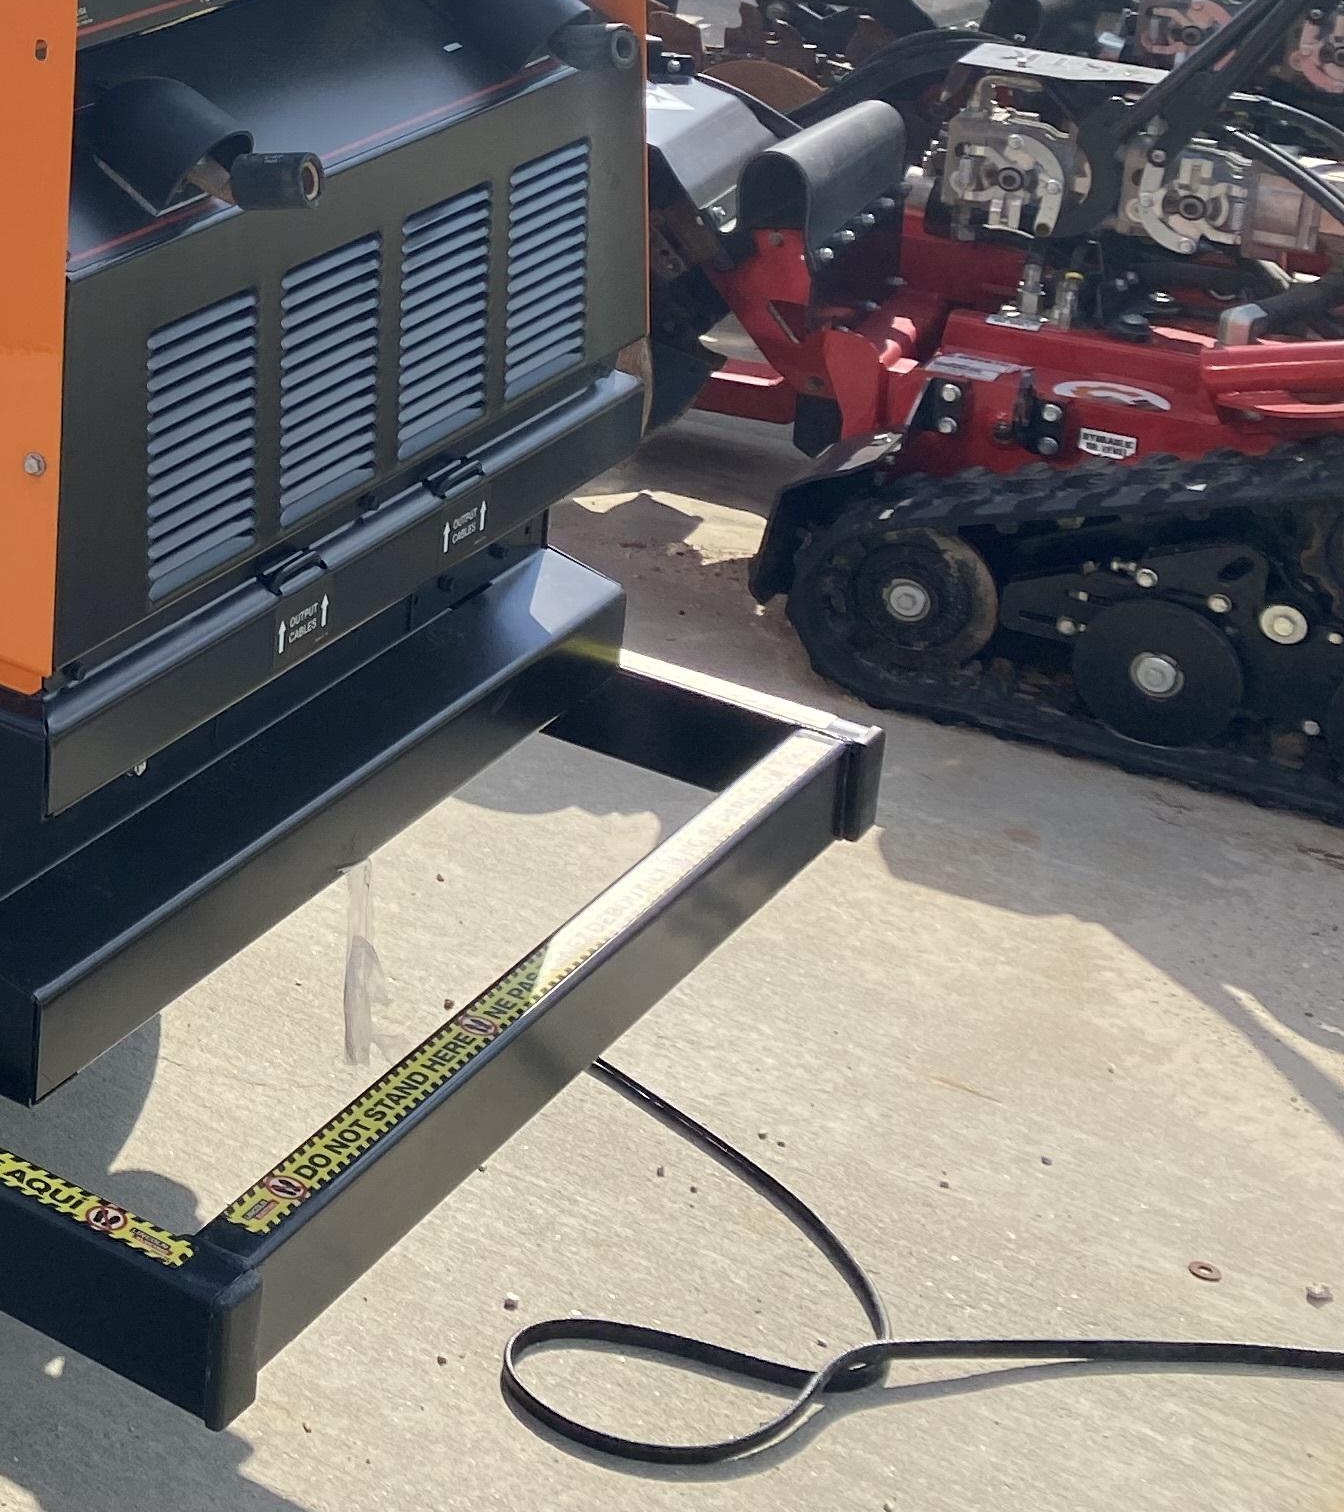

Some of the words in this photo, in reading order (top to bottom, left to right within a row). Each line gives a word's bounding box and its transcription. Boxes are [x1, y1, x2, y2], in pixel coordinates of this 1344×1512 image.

[452, 507, 478, 530] OUTPUT
[452, 522, 477, 545] CABLES
[289, 602, 320, 628] OUTPUT
[288, 618, 317, 643] CABLES
[483, 997, 513, 1020] NE
[293, 1151, 332, 1181] DO
[324, 1120, 371, 1156] NOT
[363, 1071, 430, 1122] STAND
[421, 1032, 477, 1073] HERE
